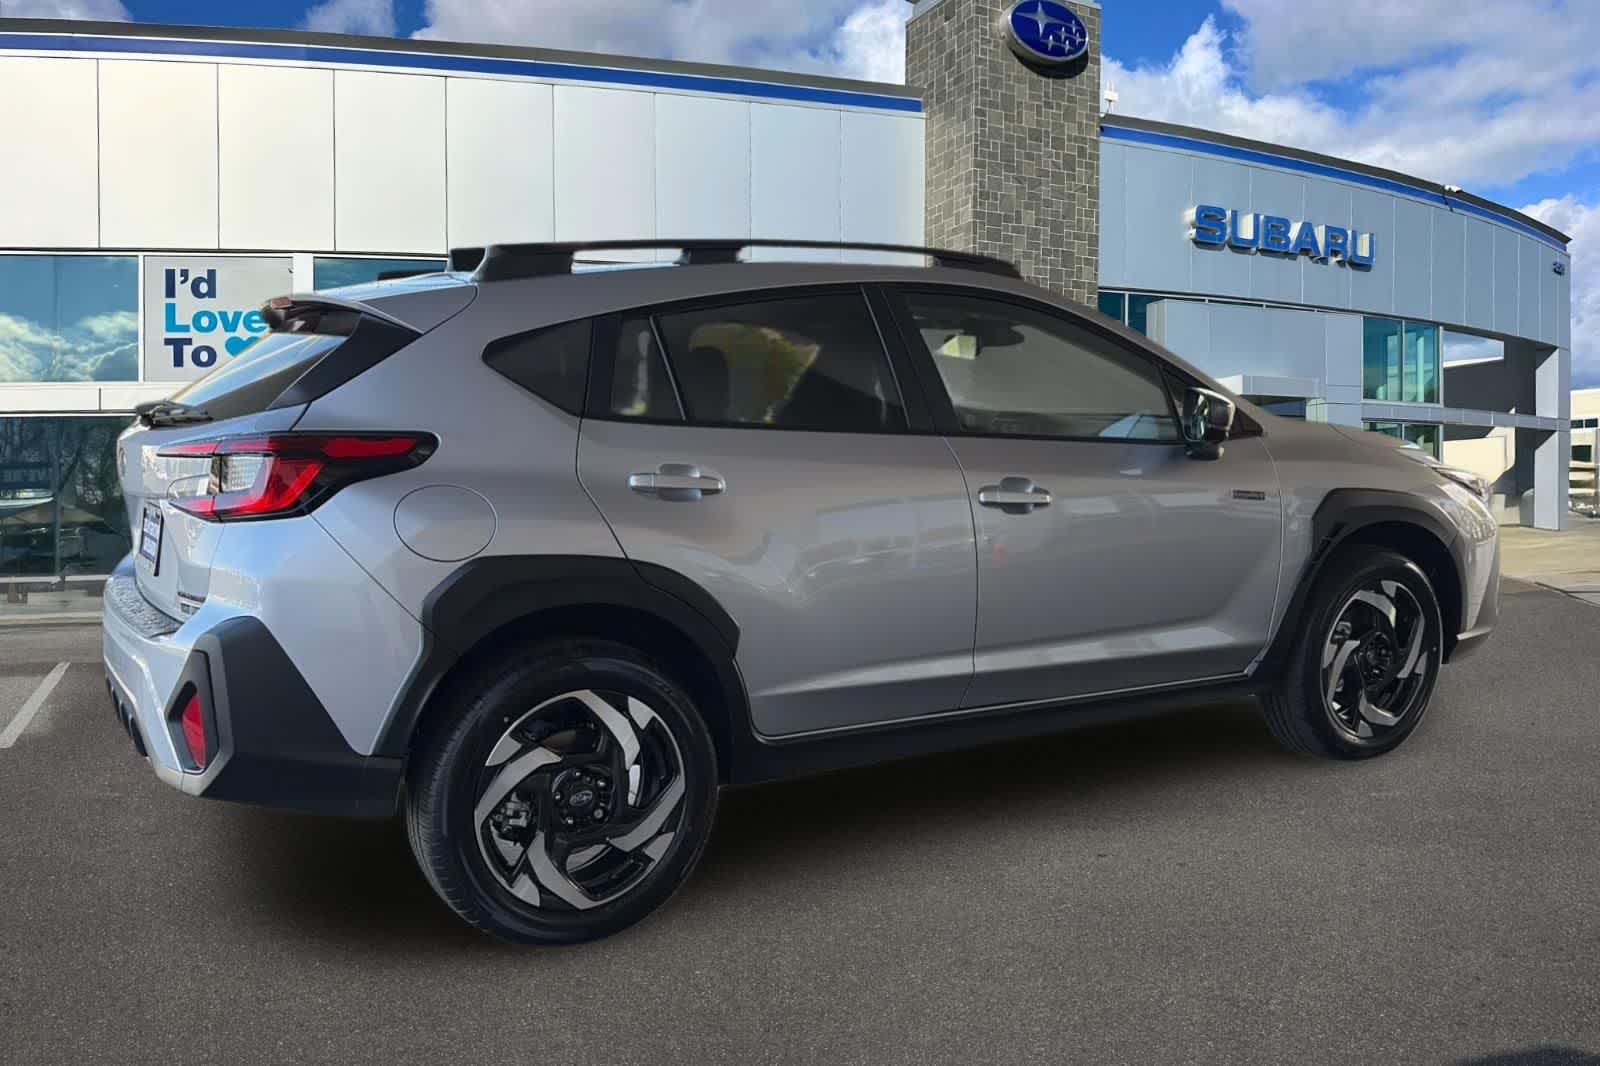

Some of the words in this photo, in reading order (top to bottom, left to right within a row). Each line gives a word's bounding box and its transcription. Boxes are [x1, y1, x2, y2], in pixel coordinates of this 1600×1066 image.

[1191, 204, 1376, 268] SUBARU
[165, 268, 217, 299] I’d
[165, 302, 268, 333] Love
[163, 337, 218, 368] To
